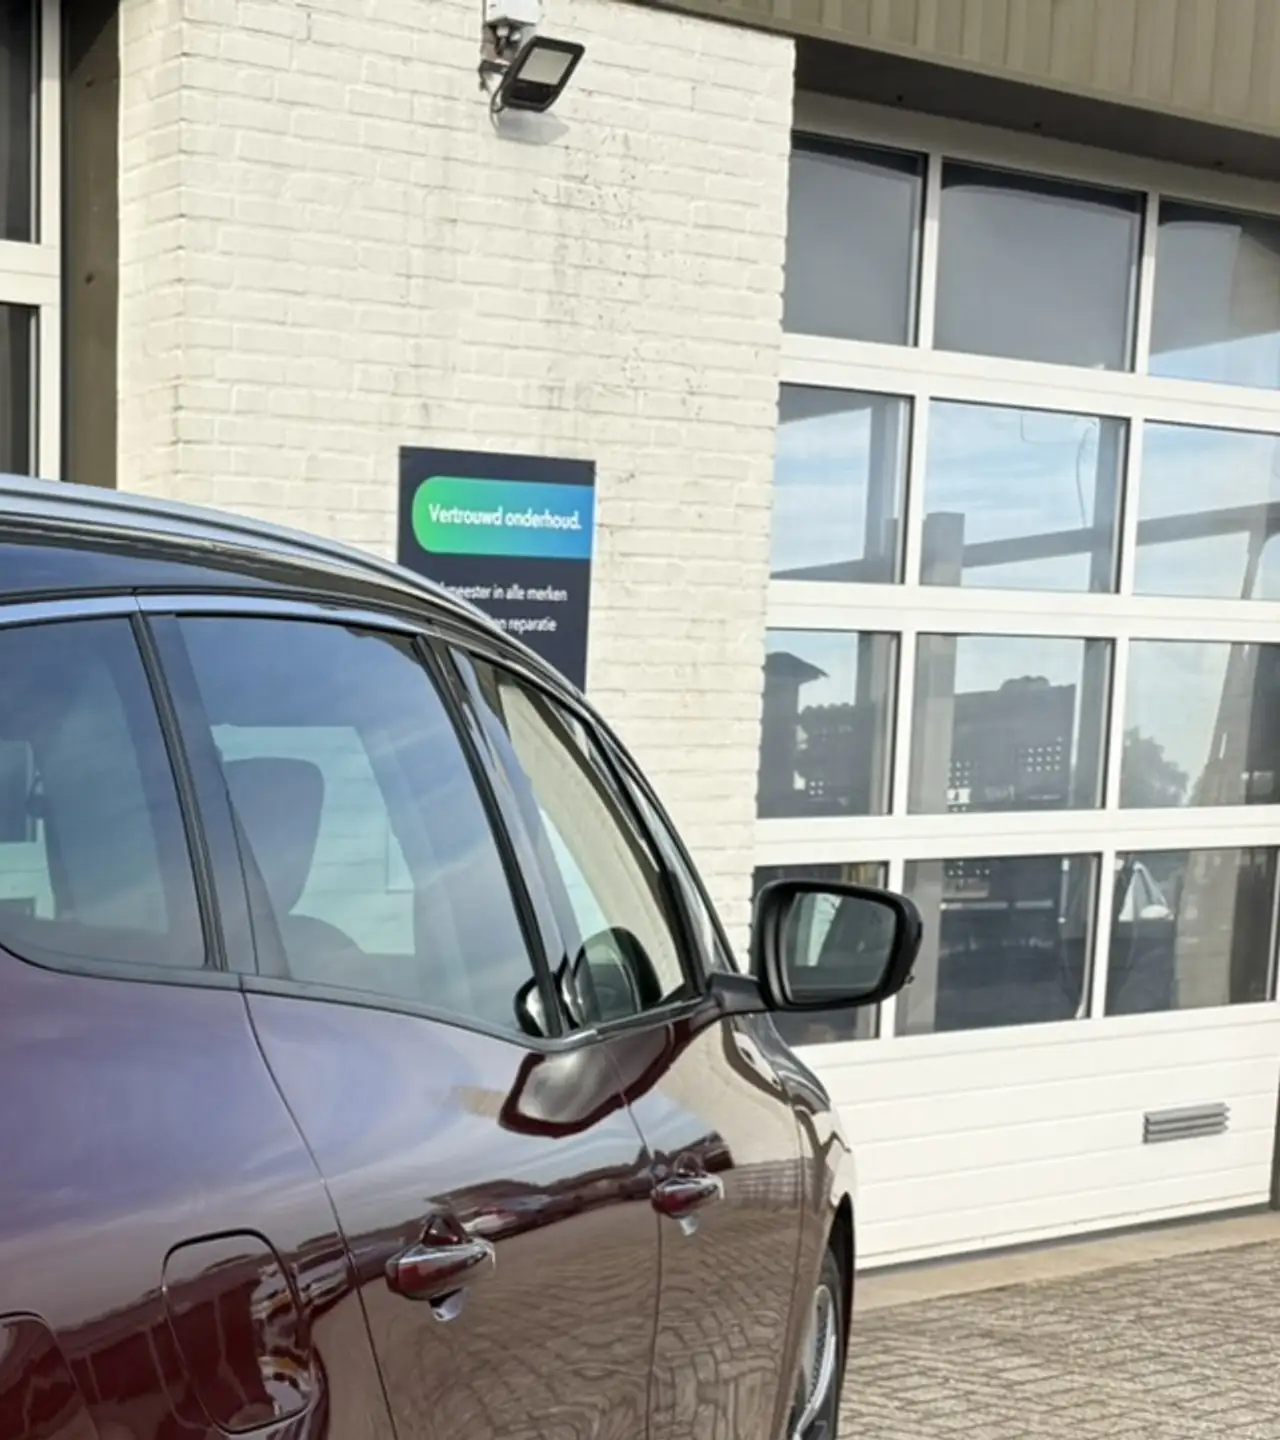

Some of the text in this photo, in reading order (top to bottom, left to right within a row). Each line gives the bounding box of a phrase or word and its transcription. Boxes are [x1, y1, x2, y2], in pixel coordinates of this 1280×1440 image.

[428, 503, 582, 531] Vertrouwd onderhoud.
[526, 585, 568, 601] merken
[508, 616, 558, 635] reparatie
